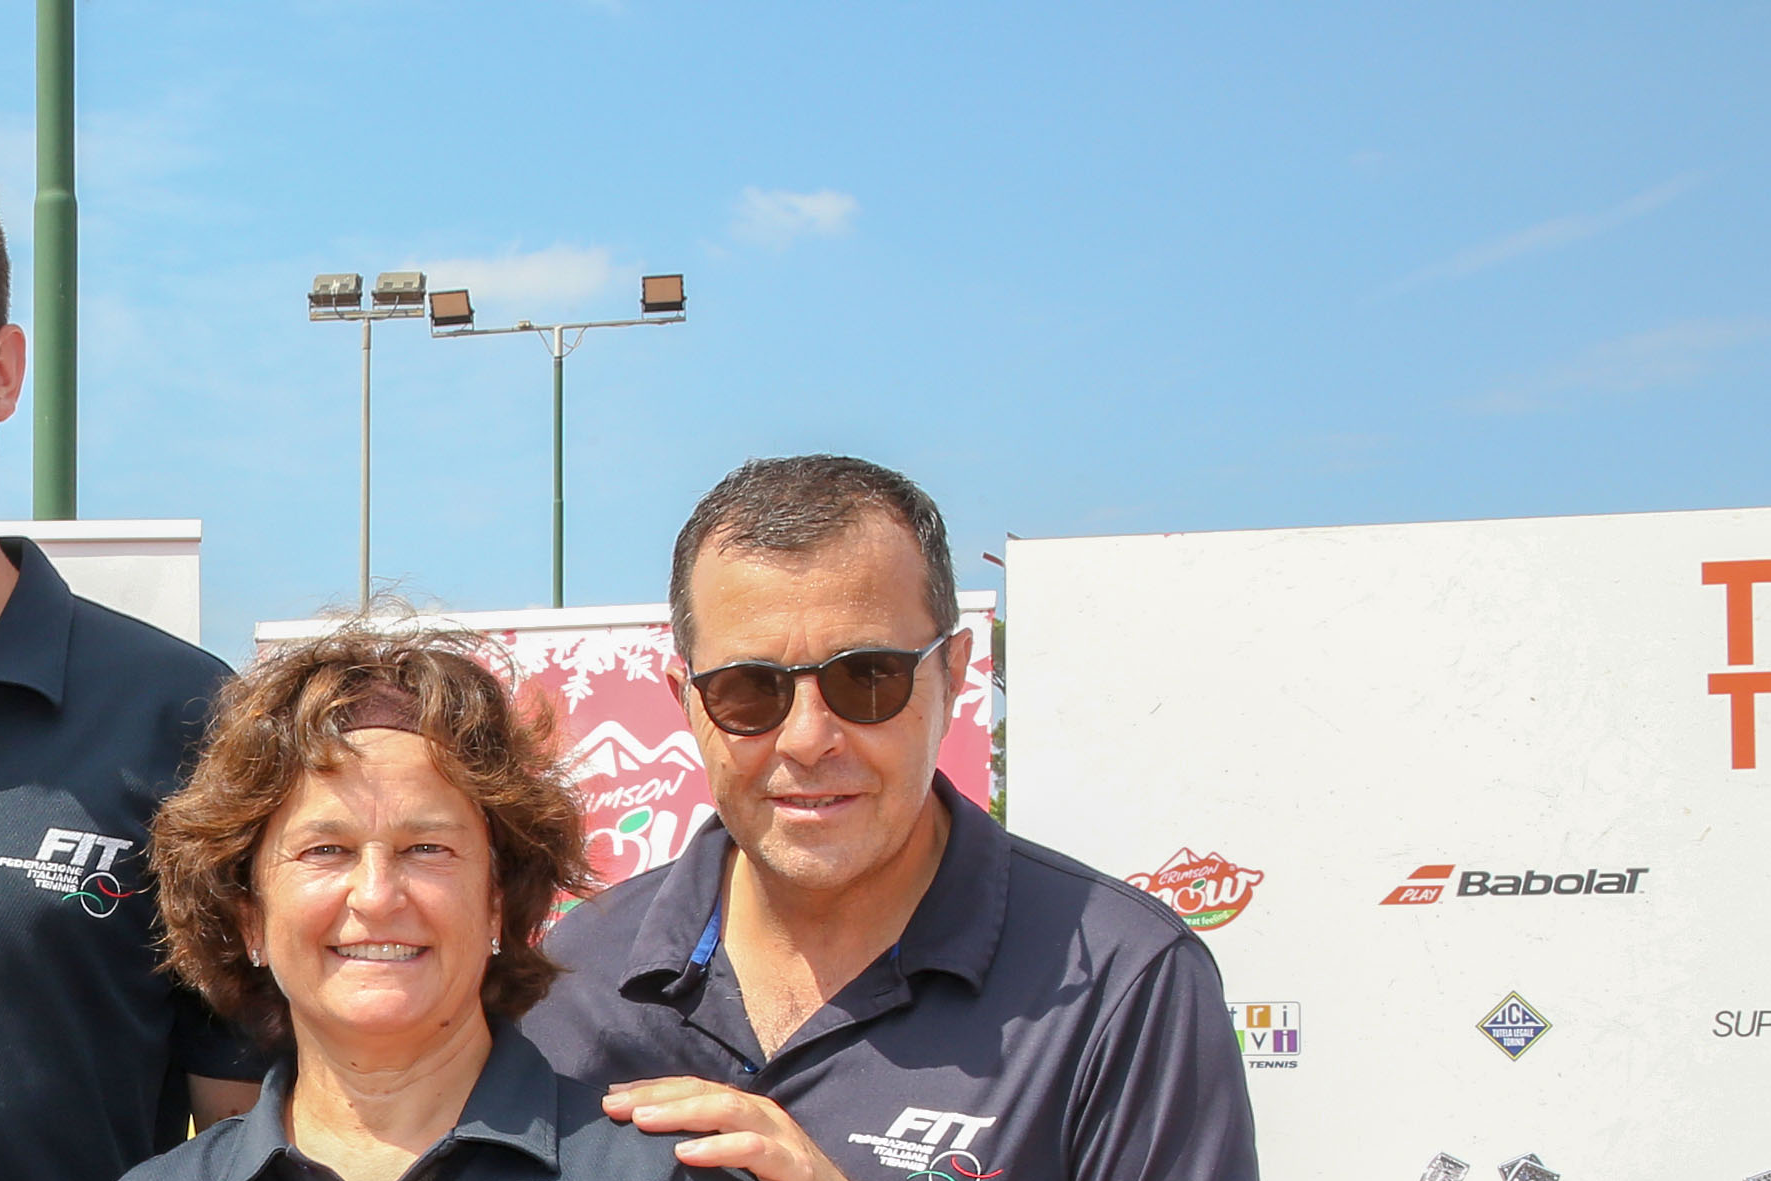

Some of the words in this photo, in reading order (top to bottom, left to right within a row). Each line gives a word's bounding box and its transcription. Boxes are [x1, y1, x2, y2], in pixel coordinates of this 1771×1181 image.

[36, 828, 133, 871] FIT
[27, 869, 79, 884] ITALIANA
[35, 879, 78, 893] TENNIS
[1399, 888, 1438, 902] PLAY
[1248, 1061, 1298, 1069] TENNIS
[885, 1106, 997, 1150] FIT
